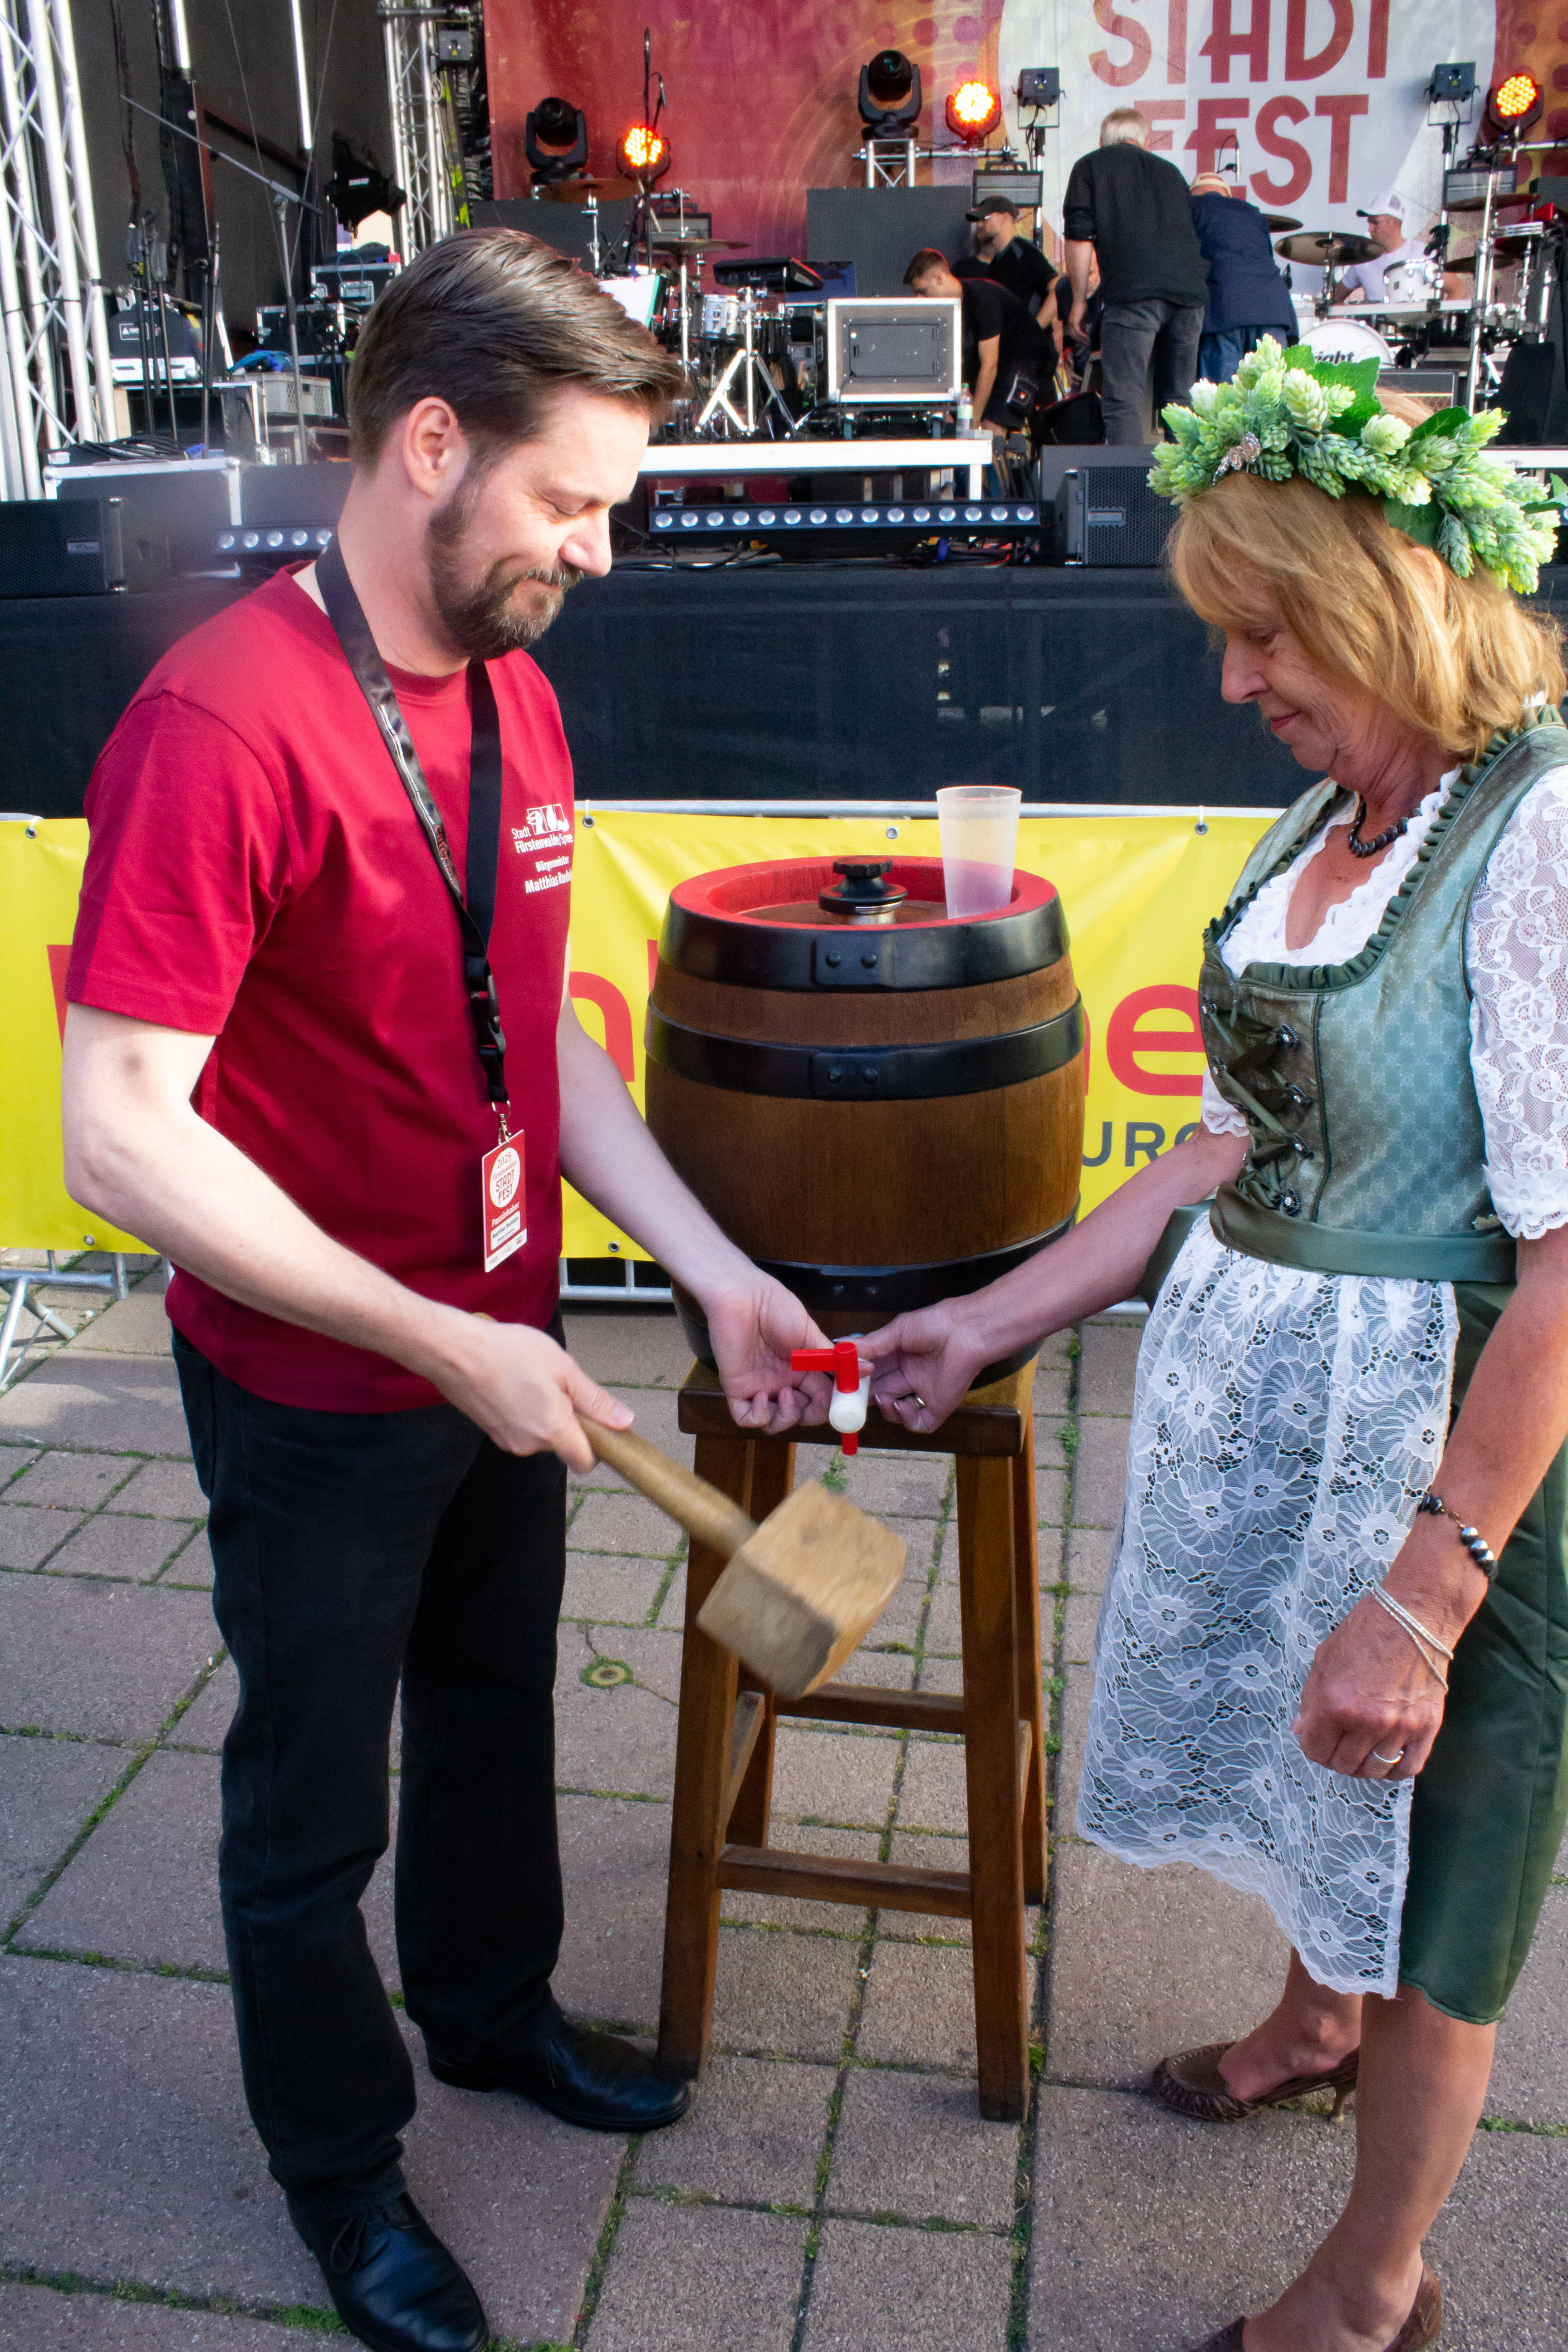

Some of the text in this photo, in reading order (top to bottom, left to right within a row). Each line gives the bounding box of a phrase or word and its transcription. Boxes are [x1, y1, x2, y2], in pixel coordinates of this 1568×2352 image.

[511, 826, 532, 839] Stadt
[535, 856, 569, 872] Bürgermeister
[525, 874, 559, 893] Matthias
[497, 1151, 512, 1169] 2025
[496, 1169, 514, 1192] STADT
[498, 1183, 513, 1204] FEST
